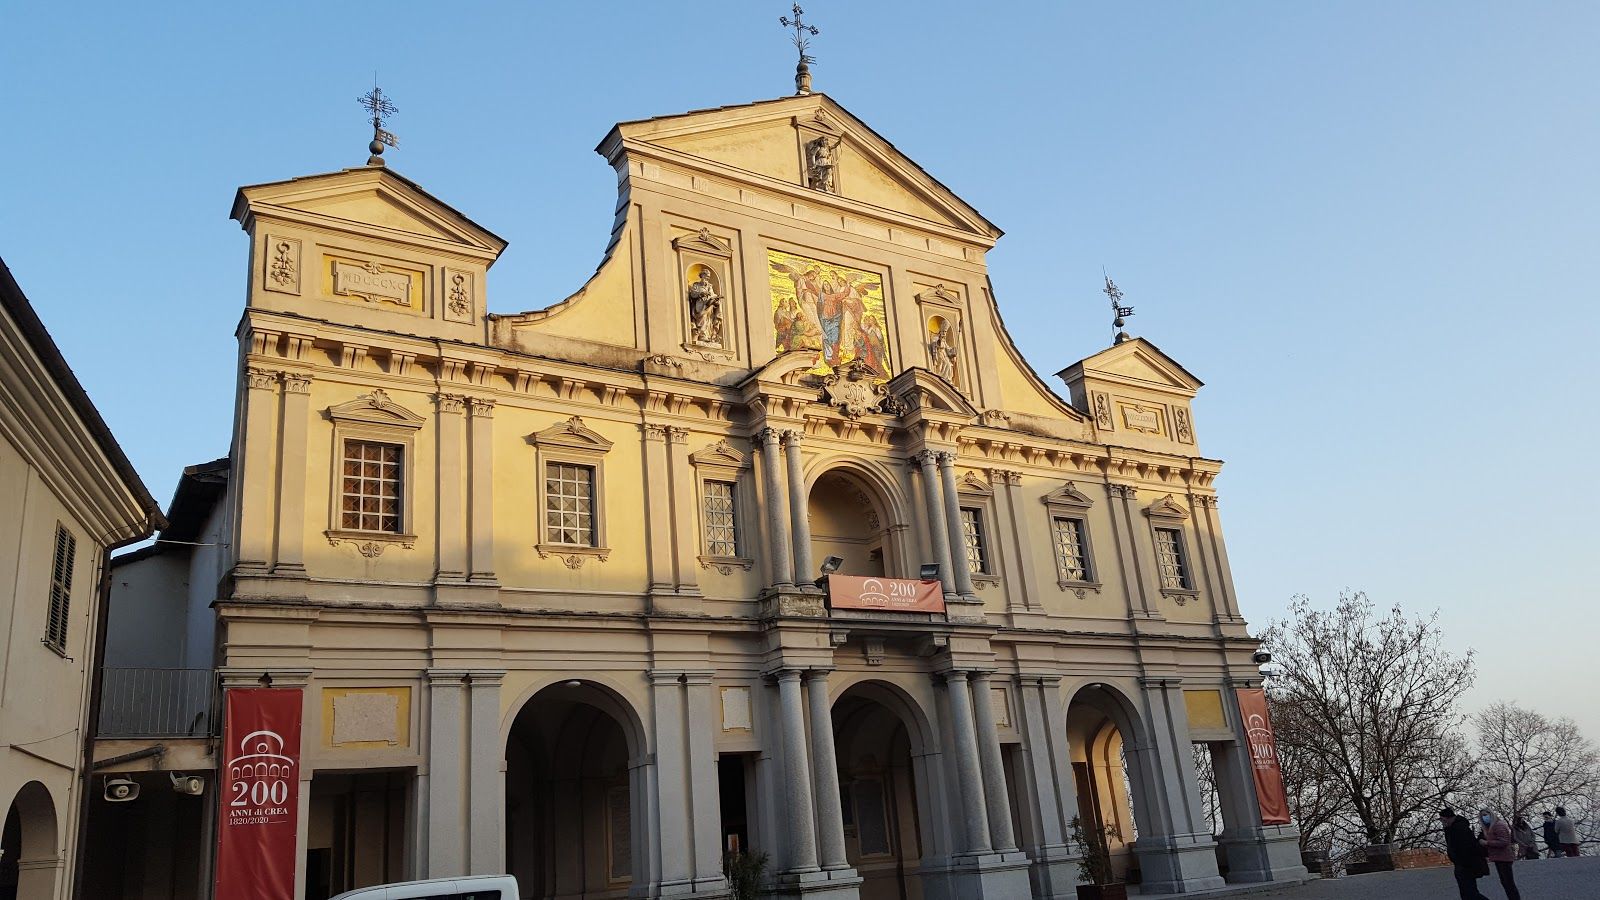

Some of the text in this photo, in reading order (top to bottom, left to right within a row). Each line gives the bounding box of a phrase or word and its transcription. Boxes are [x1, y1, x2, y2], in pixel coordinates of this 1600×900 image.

[889, 581, 916, 597] 200
[1252, 743, 1273, 759] 200
[230, 780, 288, 806] 200
[229, 807, 289, 817] ANNI di CREA
[229, 817, 269, 826] 1820/2020
